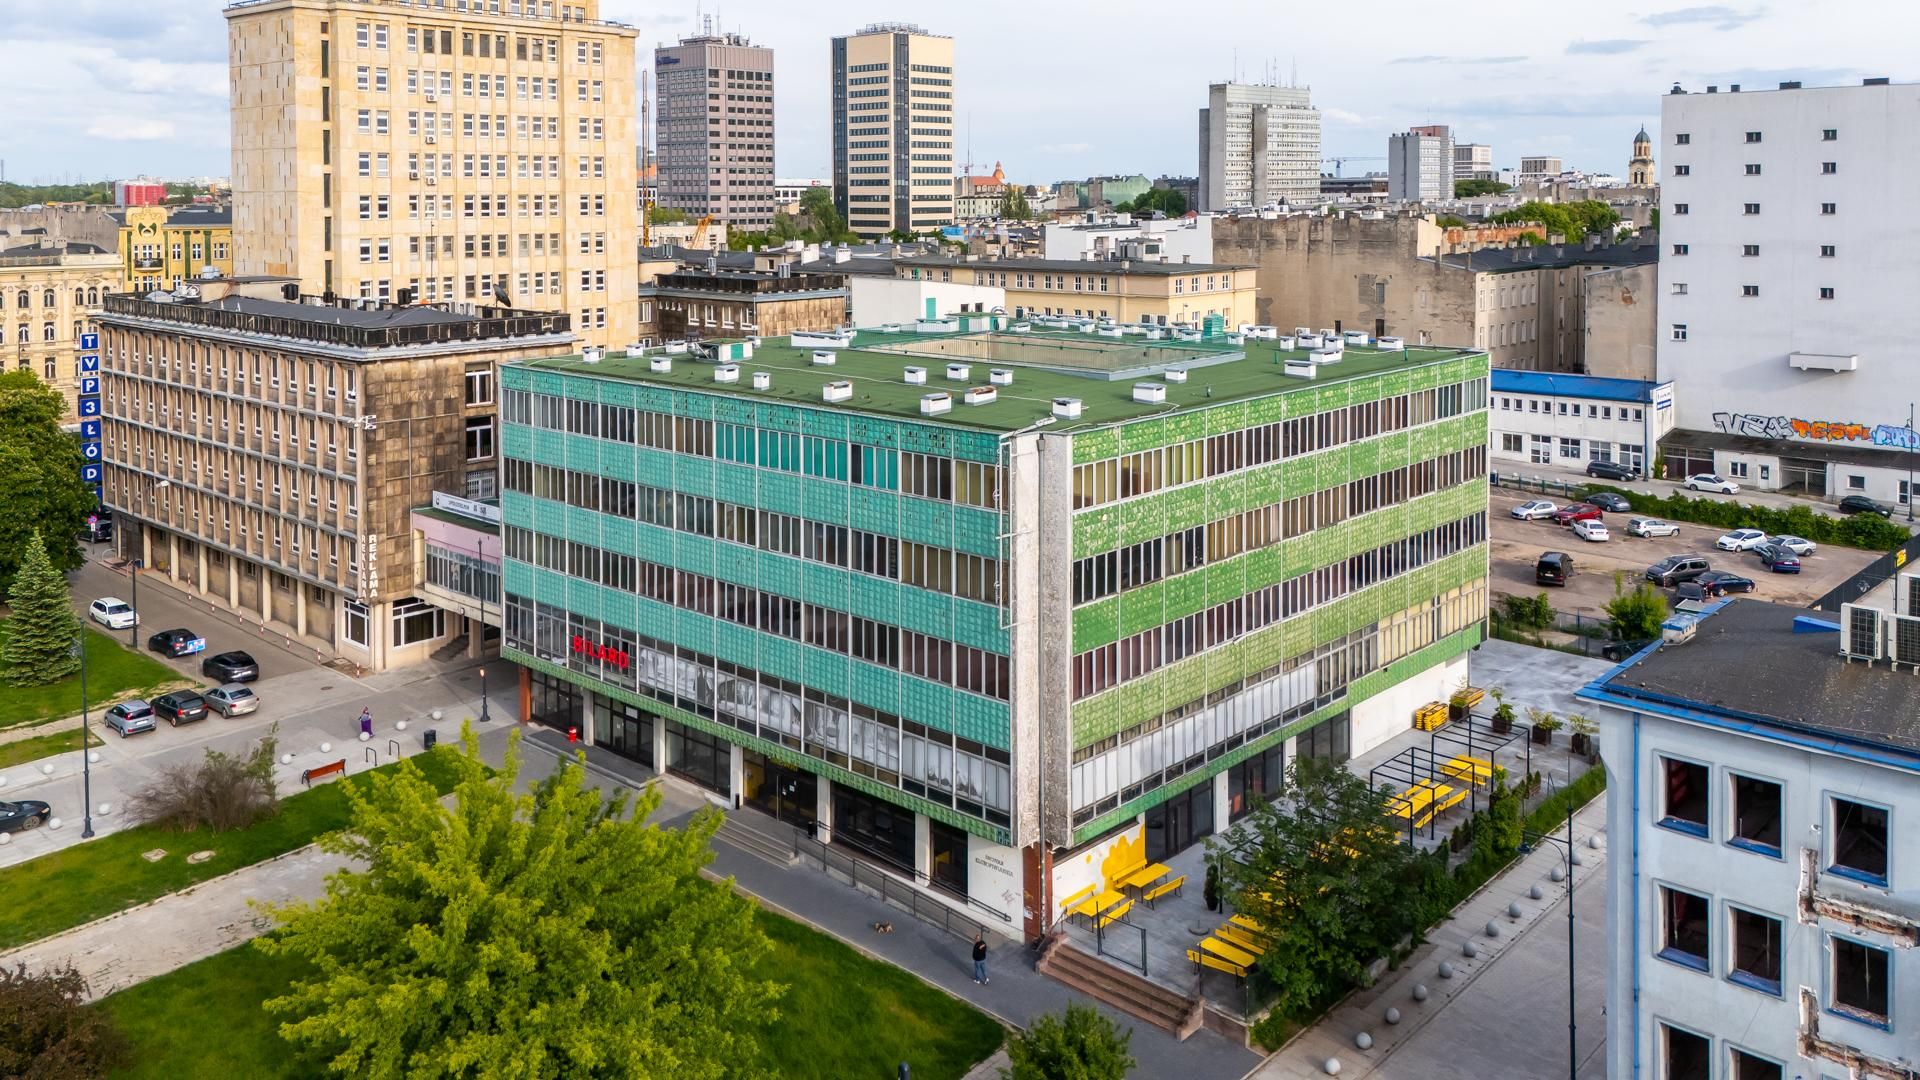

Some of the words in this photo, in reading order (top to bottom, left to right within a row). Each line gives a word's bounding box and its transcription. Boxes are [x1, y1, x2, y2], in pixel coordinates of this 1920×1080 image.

[84, 335, 96, 414] TVP3
[368, 534, 379, 598] REKLAMA
[573, 634, 629, 668] BILARD
